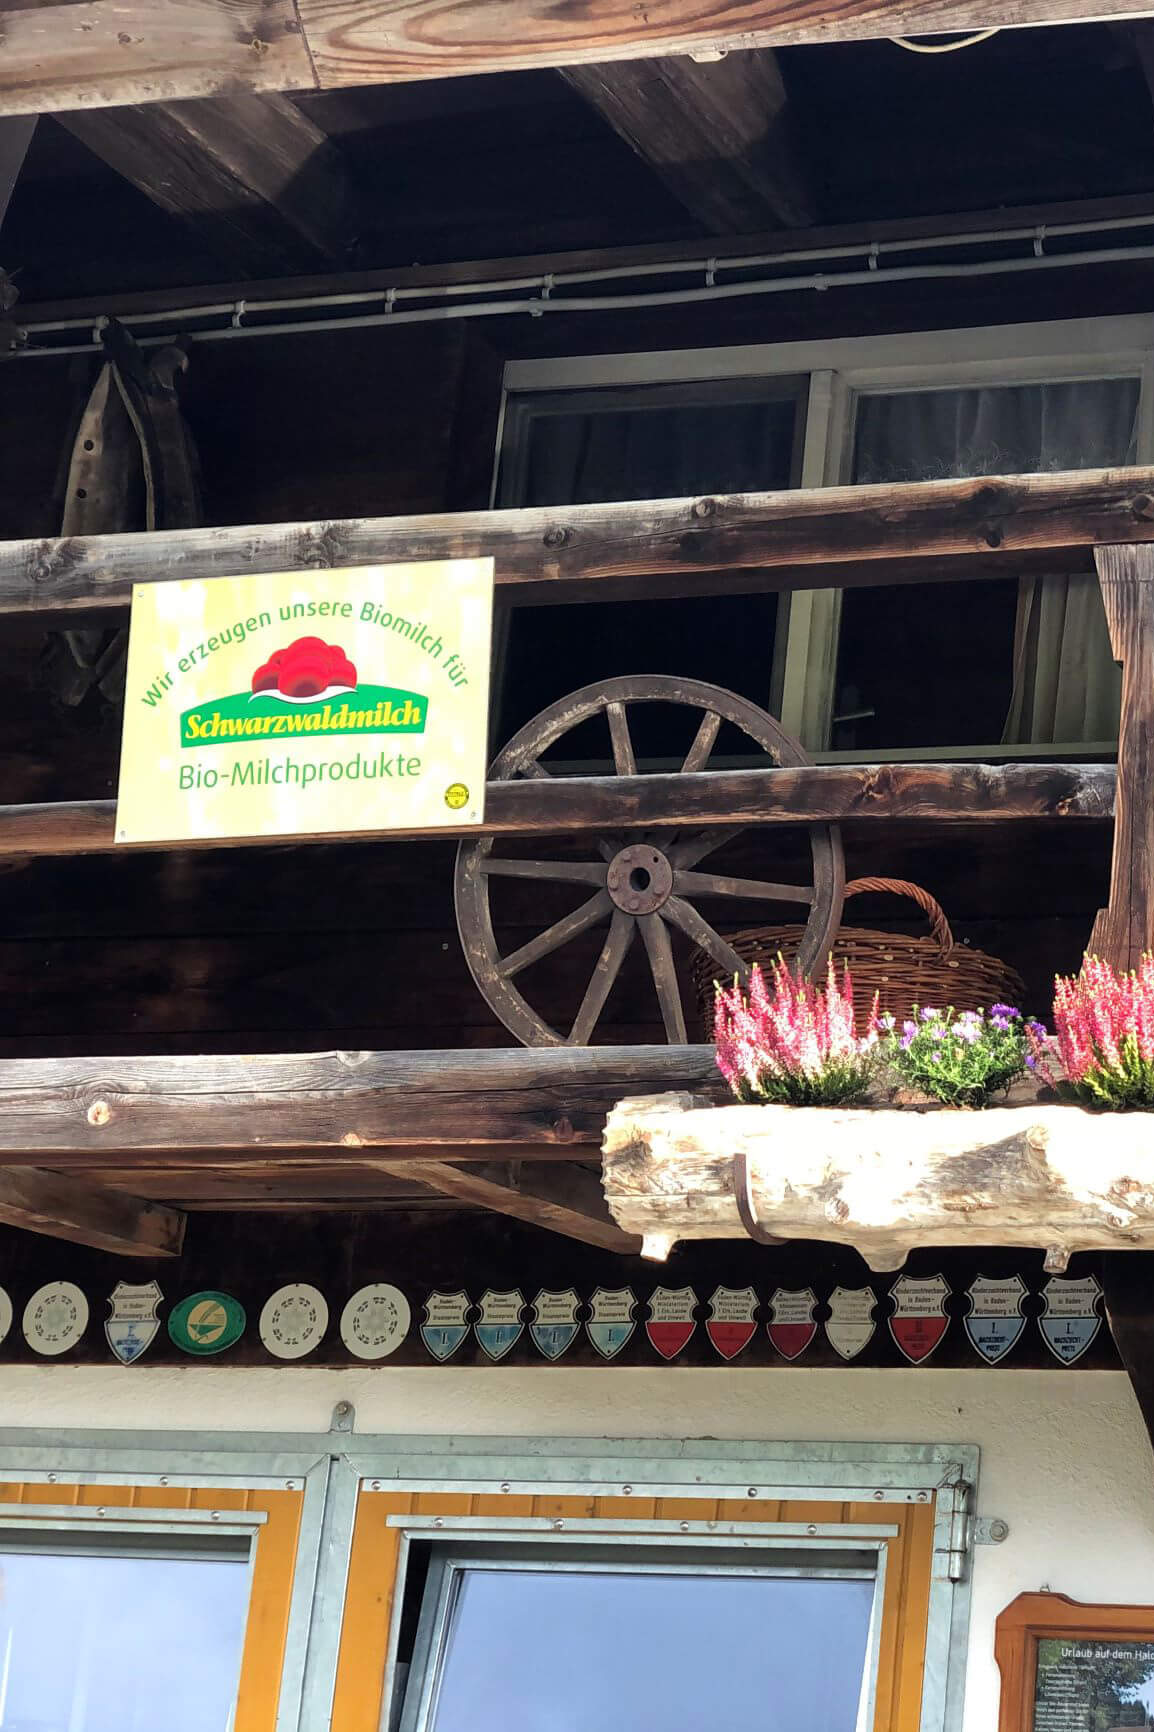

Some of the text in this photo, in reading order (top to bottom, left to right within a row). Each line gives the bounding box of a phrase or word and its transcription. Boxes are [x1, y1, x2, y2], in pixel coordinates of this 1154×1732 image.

[141, 601, 469, 708] Wir erzeugen unsere Biomilch für
[184, 699, 422, 739] Schwarzwaldmilch
[178, 751, 422, 790] Bio-Milchprodukte
[1061, 1648, 1092, 1658] Urlaub
[1094, 1648, 1110, 1659] auf
[1111, 1649, 1133, 1660] dem
